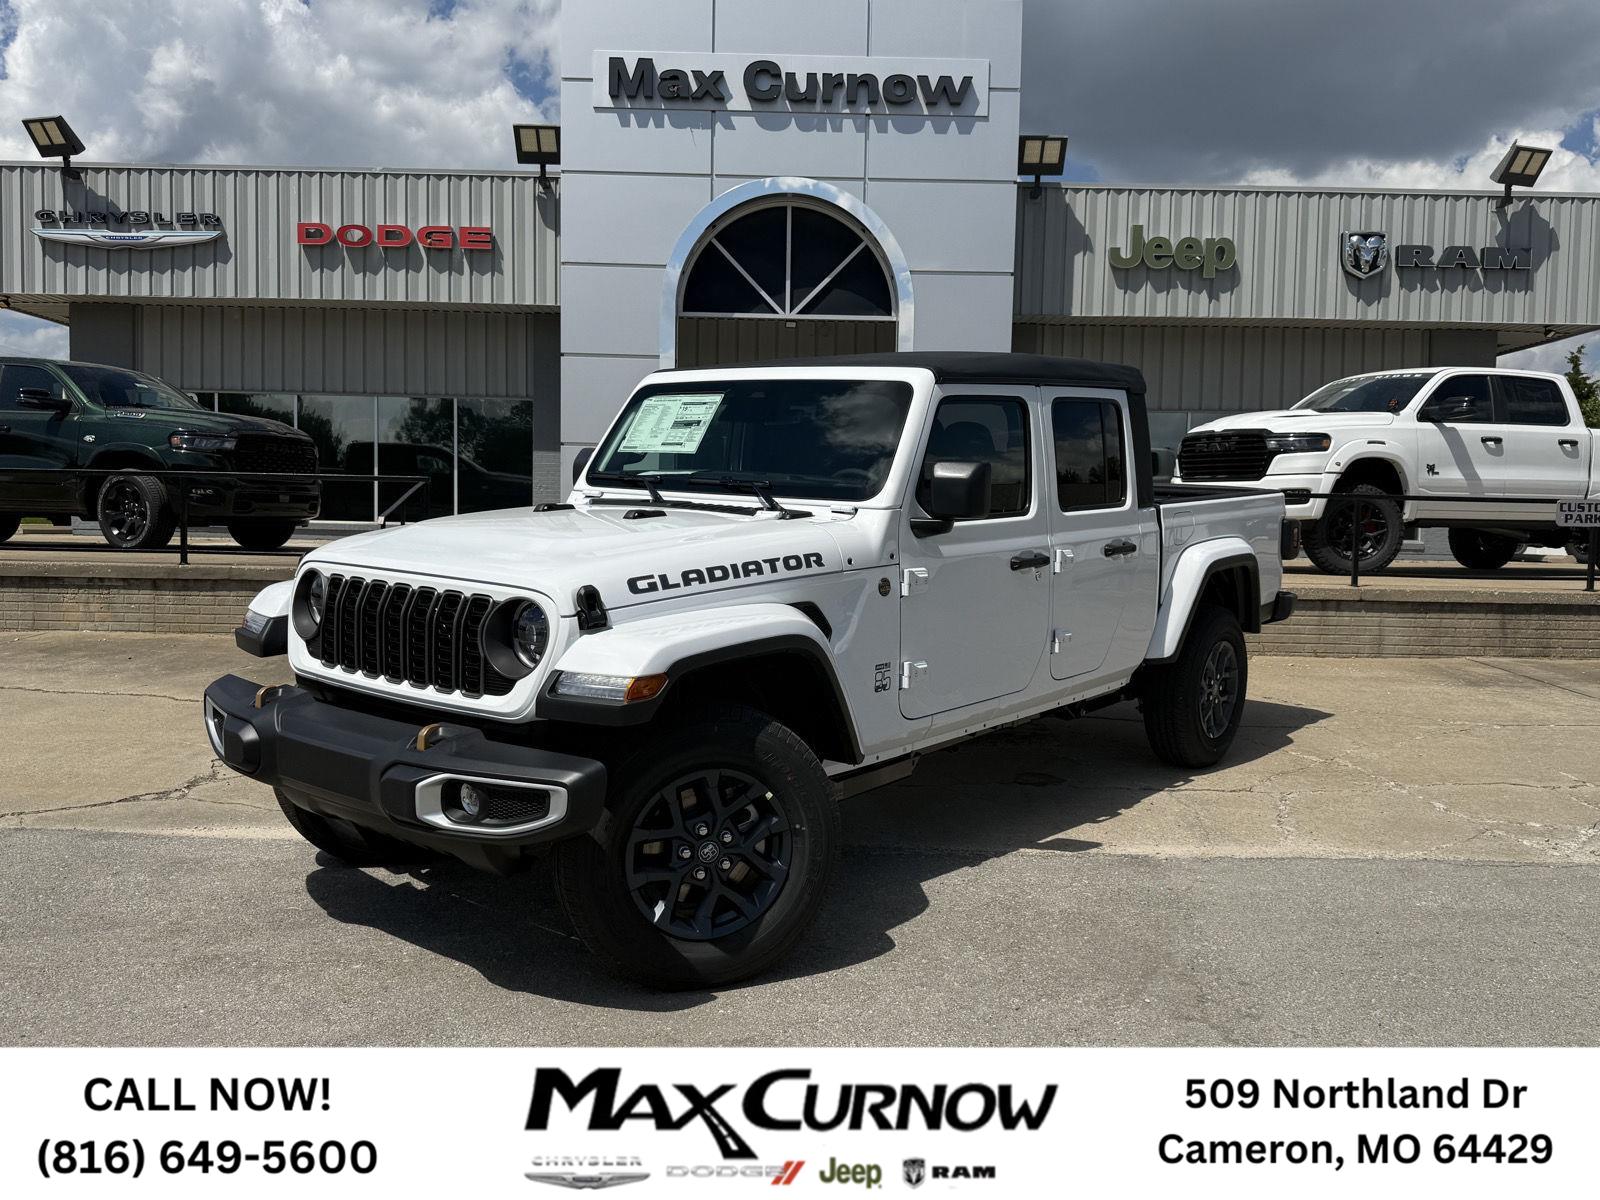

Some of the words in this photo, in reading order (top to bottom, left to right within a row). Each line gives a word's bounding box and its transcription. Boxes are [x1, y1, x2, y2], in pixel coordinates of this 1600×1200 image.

[608, 56, 727, 101] Max
[742, 59, 974, 106] Curnow
[33, 208, 221, 226] CHRYSLER
[297, 222, 492, 250] DODGE
[1108, 224, 1236, 279] Jeep
[1394, 244, 1533, 269] RAM
[626, 552, 826, 595] GLADIATOR
